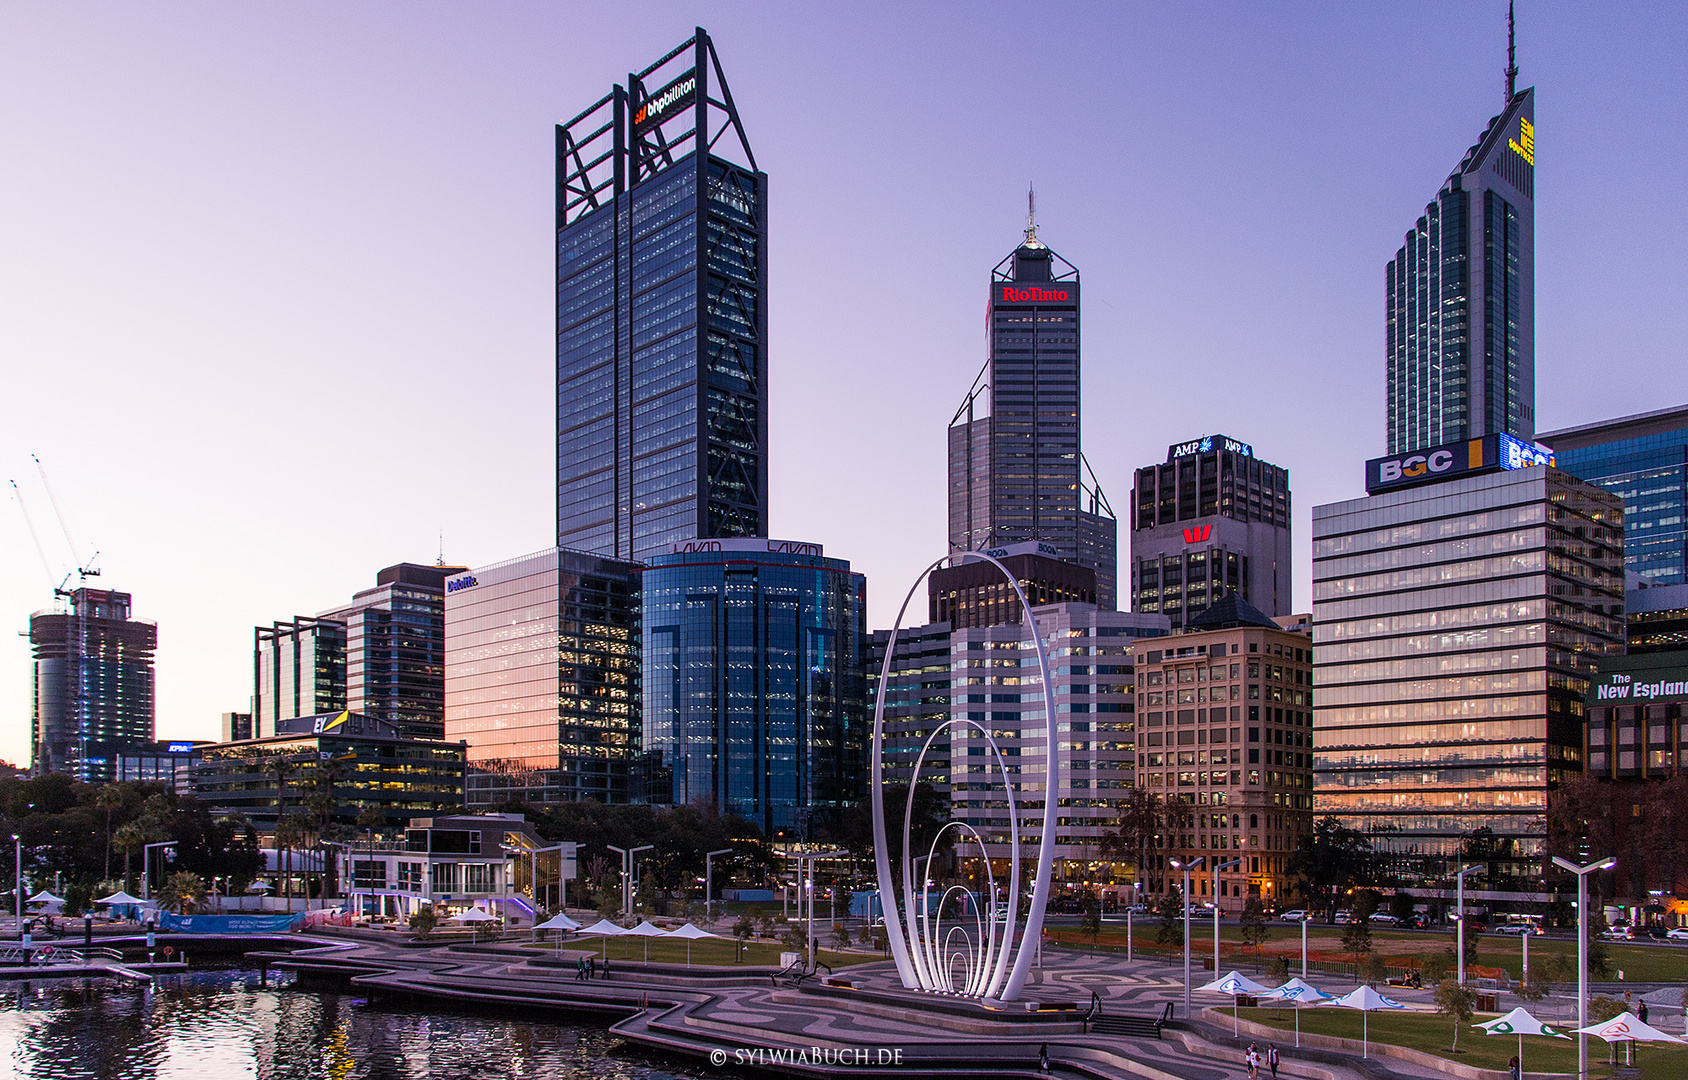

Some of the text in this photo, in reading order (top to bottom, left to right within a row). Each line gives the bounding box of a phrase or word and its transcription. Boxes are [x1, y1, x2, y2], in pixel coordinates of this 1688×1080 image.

[647, 77, 696, 117] bhpbilliton
[1173, 441, 1200, 458] AMP
[1224, 438, 1241, 454] AMP
[1379, 450, 1453, 483] BGC
[767, 541, 818, 556] LAVAN
[1611, 674, 1631, 684] The
[1597, 684, 1630, 700] New
[313, 716, 328, 733] EY
[320, 751, 333, 760] EY
